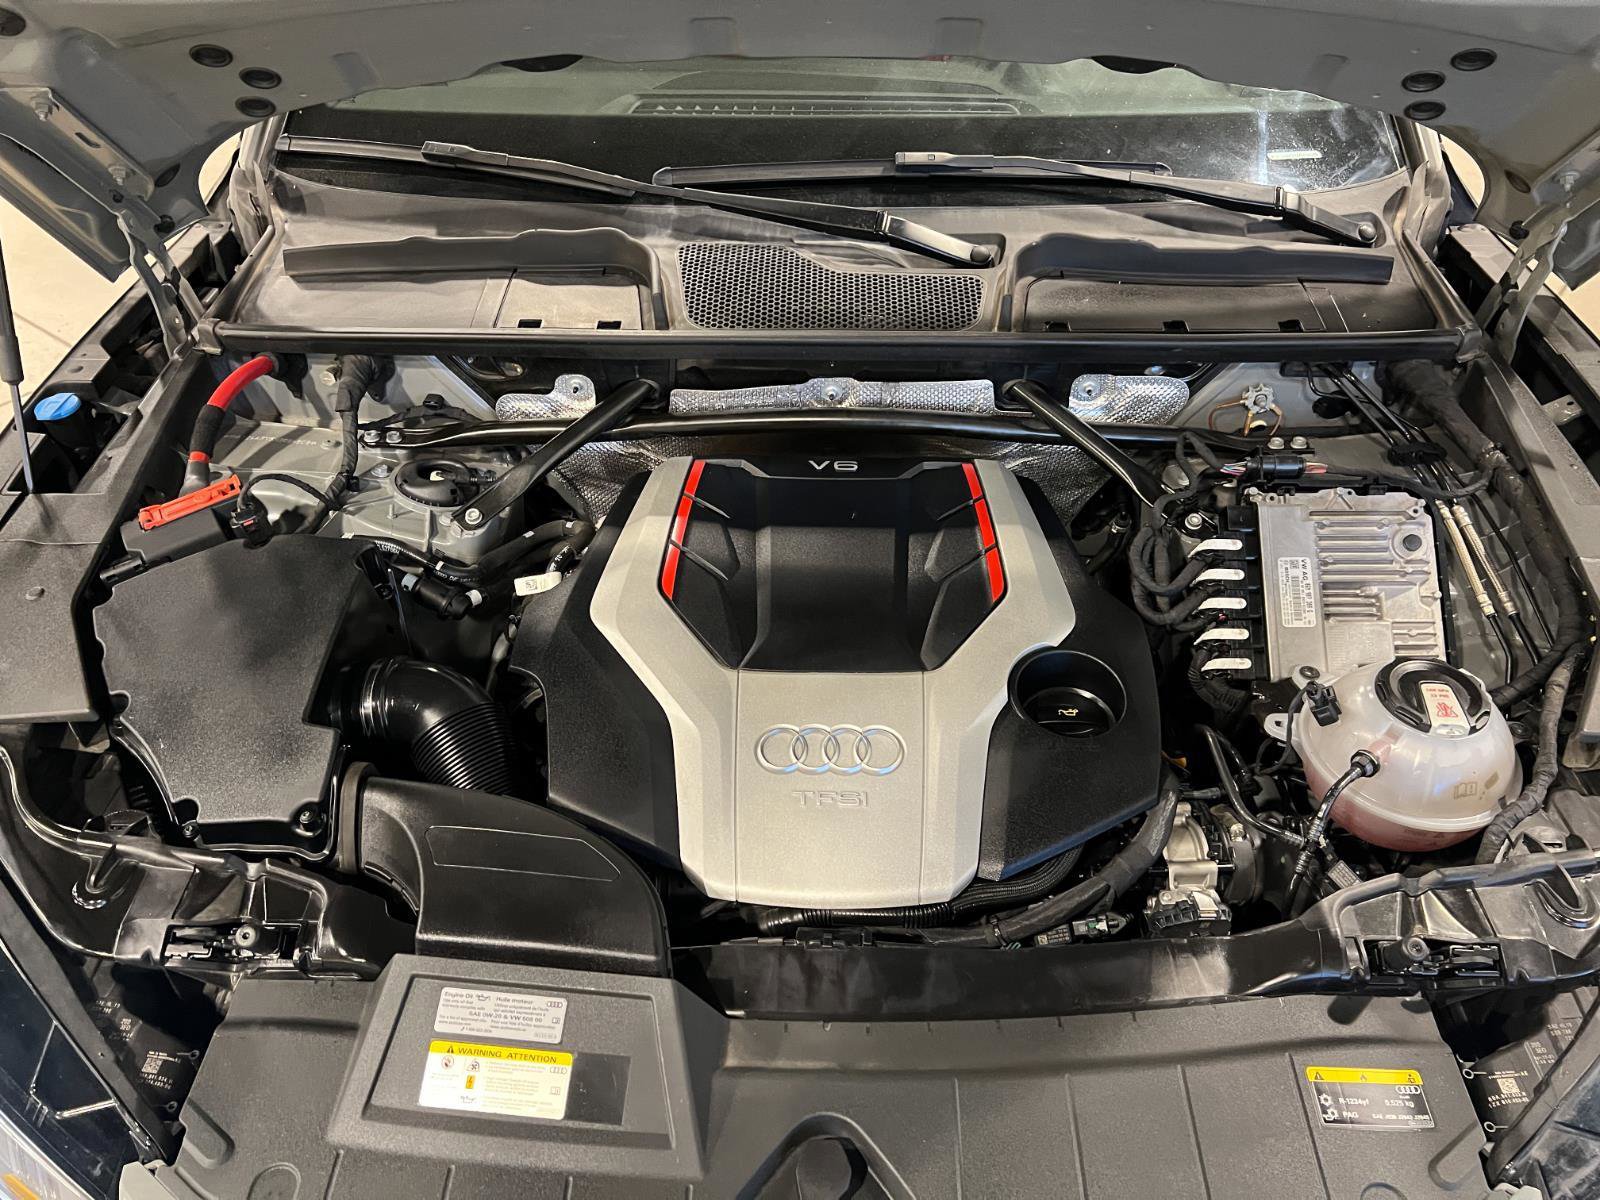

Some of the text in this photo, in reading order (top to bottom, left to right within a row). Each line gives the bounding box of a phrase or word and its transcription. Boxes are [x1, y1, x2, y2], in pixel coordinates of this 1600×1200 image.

[808, 460, 859, 472] V6
[1301, 559, 1307, 569] VW
[1303, 572, 1308, 580] AG
[792, 790, 868, 808] TFSI
[458, 1047, 557, 1063] WARNING ATTENTION
